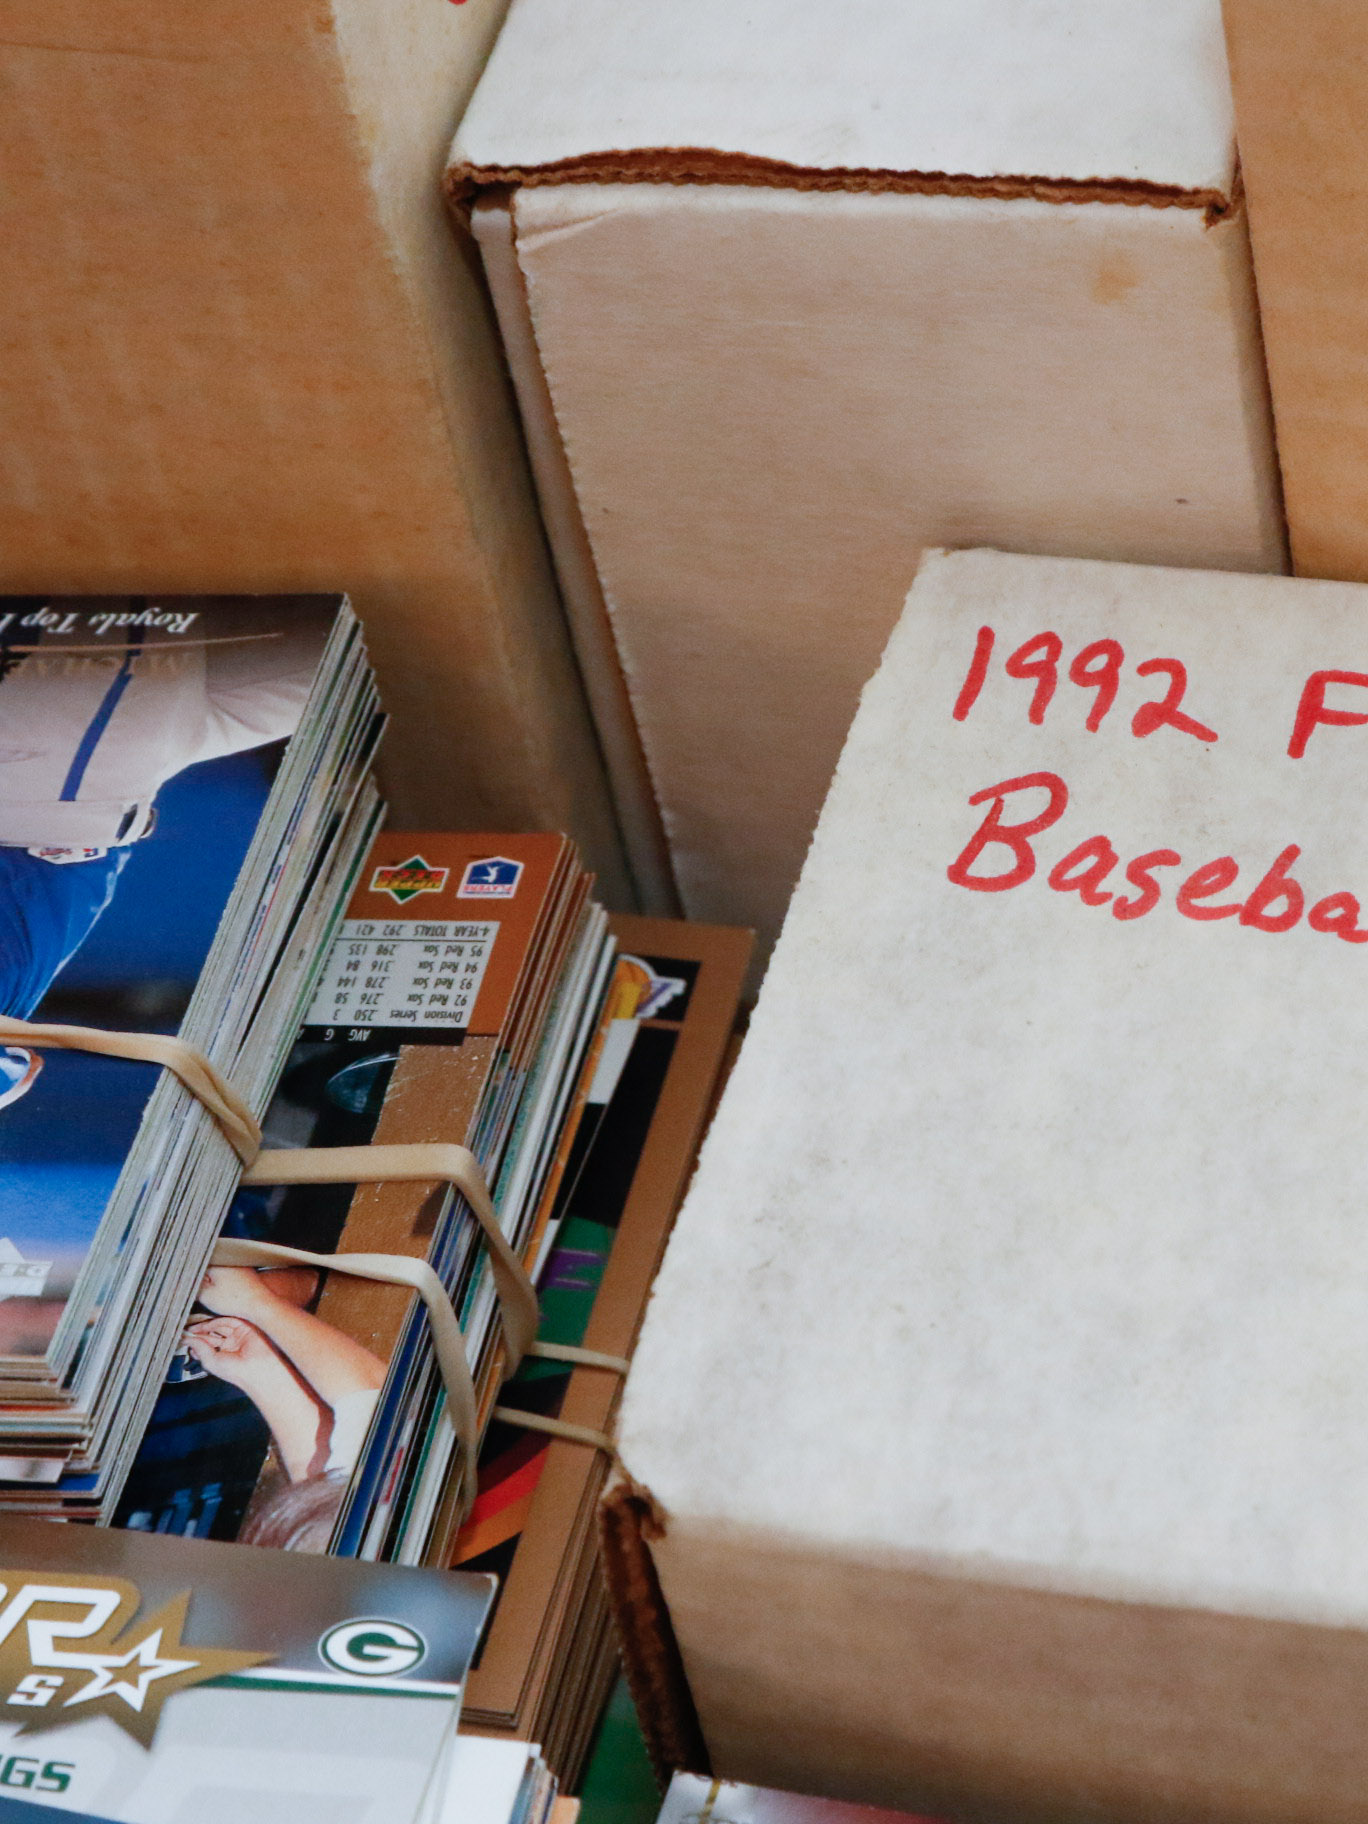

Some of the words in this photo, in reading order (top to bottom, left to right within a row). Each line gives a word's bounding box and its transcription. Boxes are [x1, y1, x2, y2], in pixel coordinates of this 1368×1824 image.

[20, 606, 80, 634] Top
[87, 607, 199, 634] Royals
[953, 626, 1218, 742] 1992
[356, 924, 375, 935] 421
[382, 924, 406, 936] .292
[414, 924, 448, 936] TOTALS
[454, 925, 490, 937] 4-YEAR
[348, 944, 368, 955] 135
[376, 944, 400, 955] .298
[423, 945, 439, 955] Sox
[445, 945, 464, 956] Red
[471, 946, 484, 956] 95
[347, 960, 360, 971] 84
[371, 960, 394, 972] .316
[418, 961, 434, 972] Sox
[440, 962, 459, 973] Red
[466, 962, 478, 973] 94
[337, 976, 357, 987] 144
[365, 976, 389, 988] .278
[413, 977, 429, 988] Sox
[434, 978, 454, 989] Red
[460, 978, 473, 989] 93
[334, 993, 349, 1003] 58
[360, 993, 384, 1004] .276
[407, 994, 424, 1004] Sox
[429, 994, 449, 1005] Red
[454, 995, 468, 1005] 92
[332, 1009, 341, 1020] 3
[353, 1009, 378, 1020] .250
[389, 1010, 418, 1021] Series
[423, 1011, 463, 1022] Division
[325, 1028, 335, 1040] G
[348, 1029, 371, 1041] AVG
[0, 1755, 75, 1793] GS
